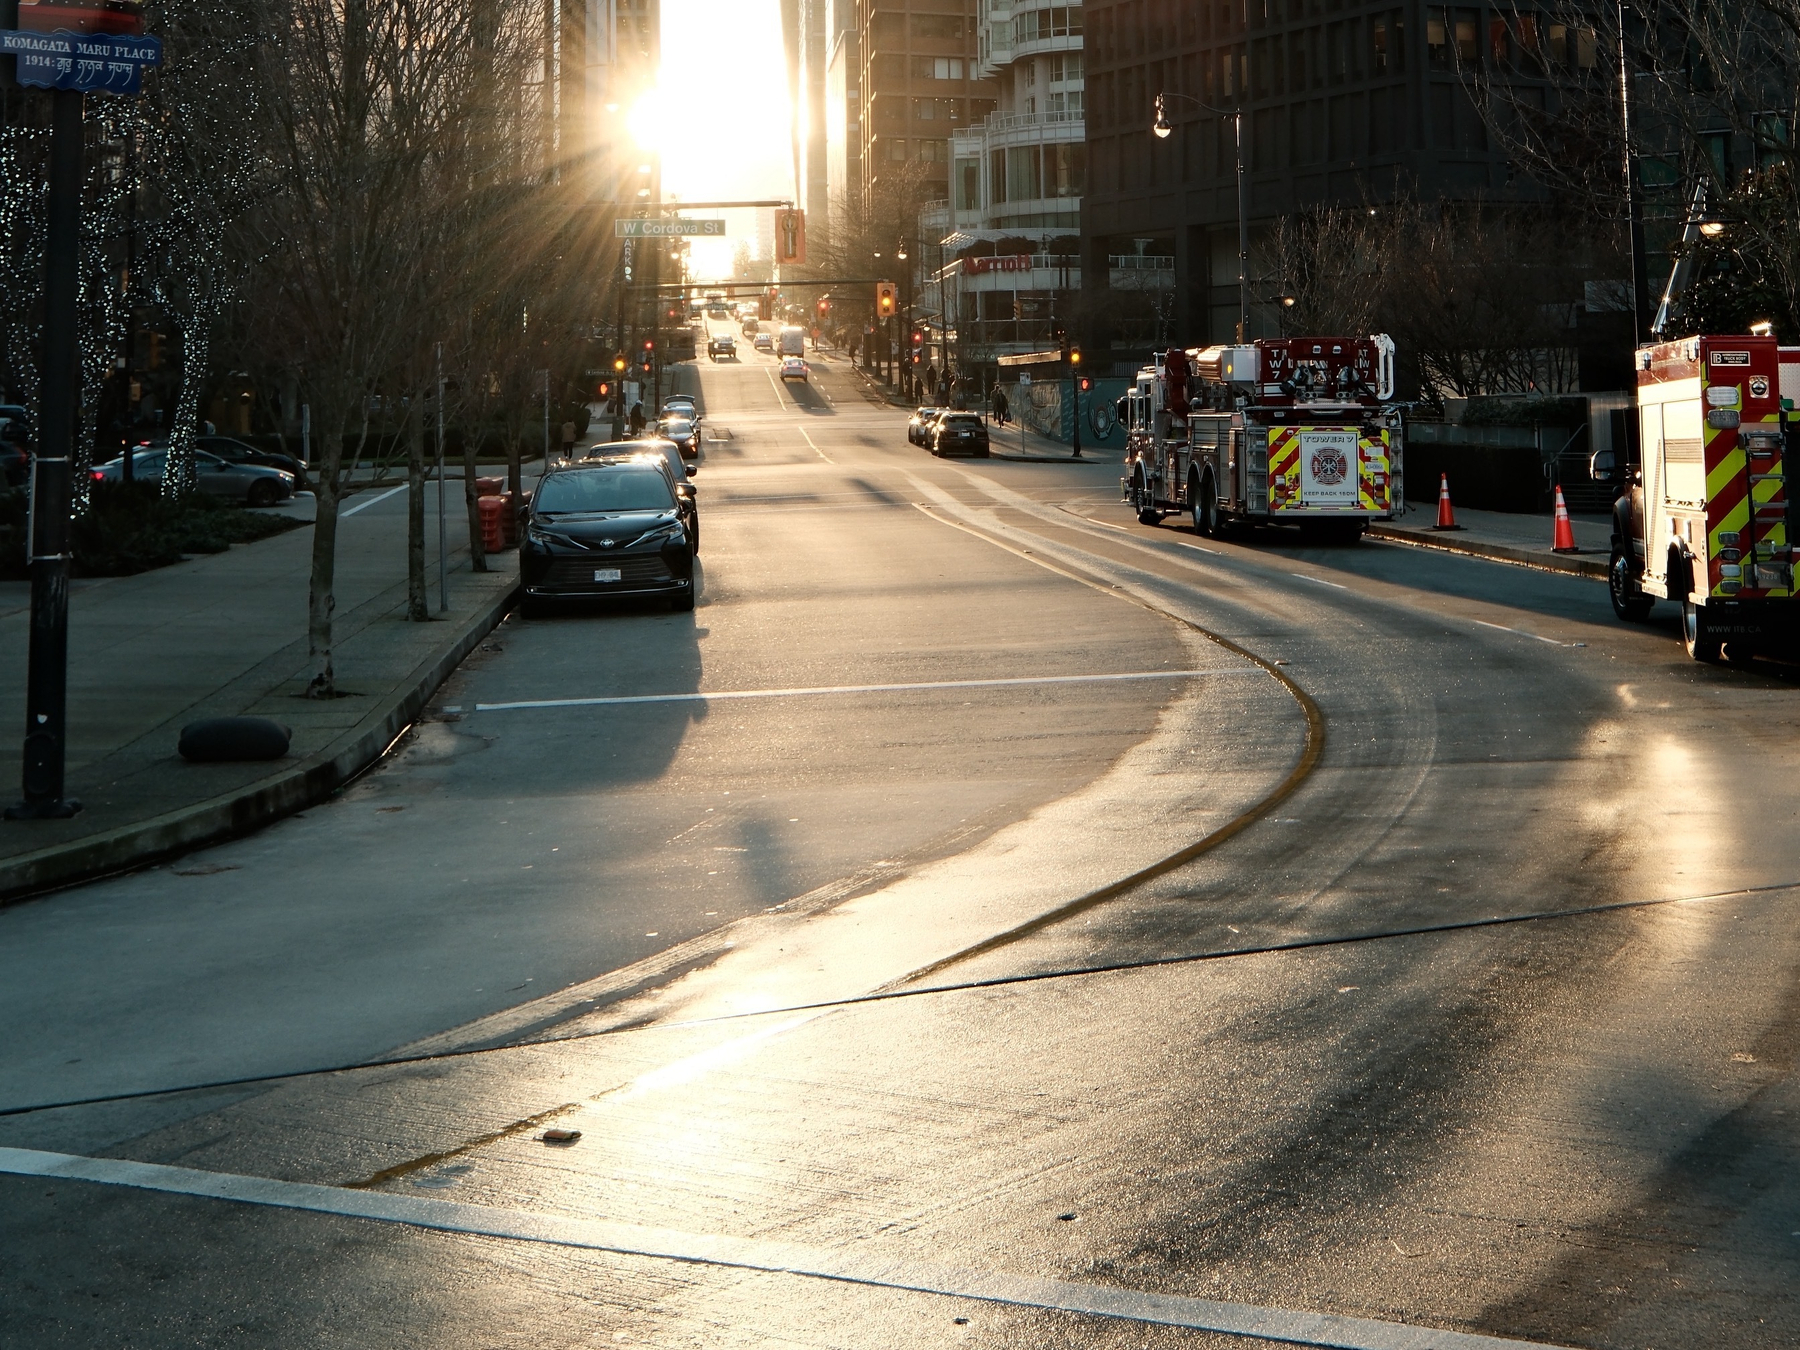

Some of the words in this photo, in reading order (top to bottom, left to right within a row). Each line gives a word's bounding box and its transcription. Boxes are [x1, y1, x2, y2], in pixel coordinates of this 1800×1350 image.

[3, 36, 71, 53] KOMAGATA
[76, 43, 110, 56] MARU
[114, 46, 156, 60] PLACE
[623, 222, 637, 233] W
[642, 222, 698, 234] Cordova
[704, 222, 719, 233] St
[624, 239, 632, 265] ARK
[960, 254, 1032, 276] Marriott
